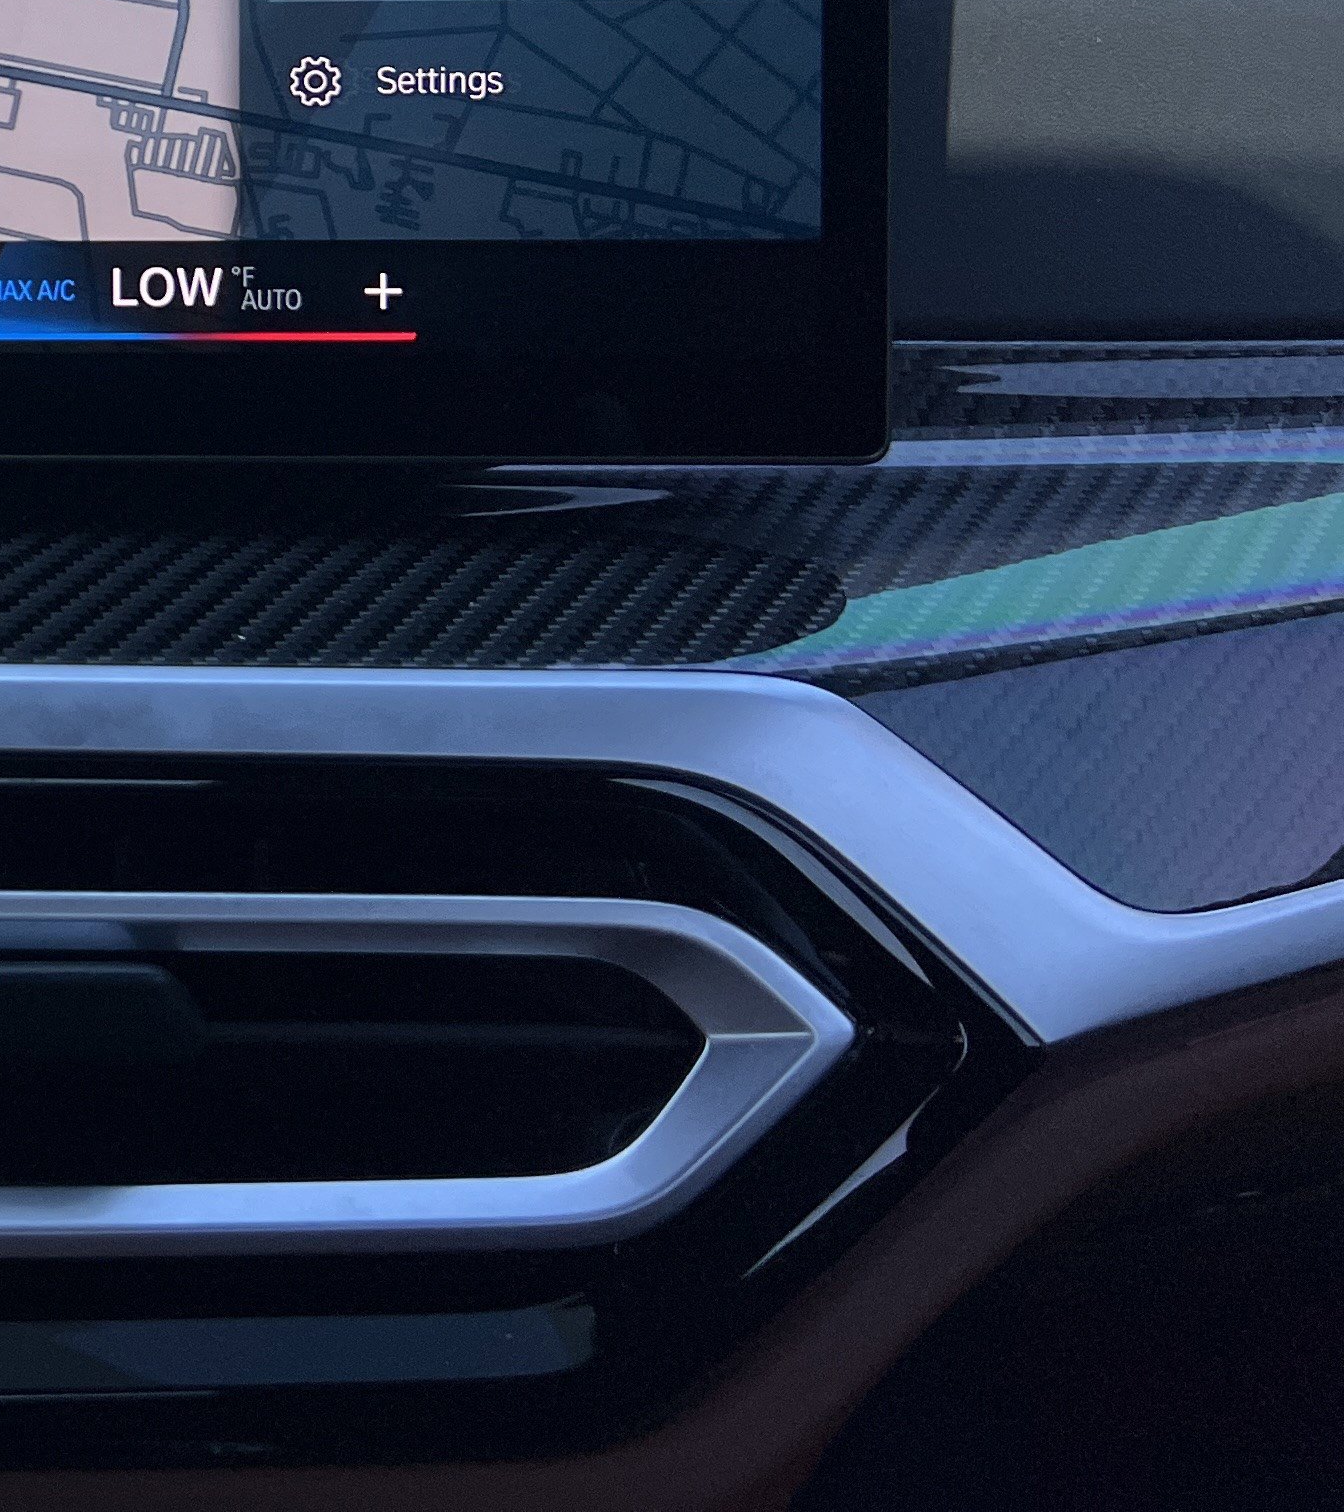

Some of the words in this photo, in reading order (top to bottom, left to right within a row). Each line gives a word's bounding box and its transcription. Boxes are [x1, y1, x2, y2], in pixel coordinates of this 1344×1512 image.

[376, 66, 504, 100] Settings
[36, 279, 76, 302] A/C
[112, 266, 224, 308] LOW
[240, 288, 302, 311] AUTO
